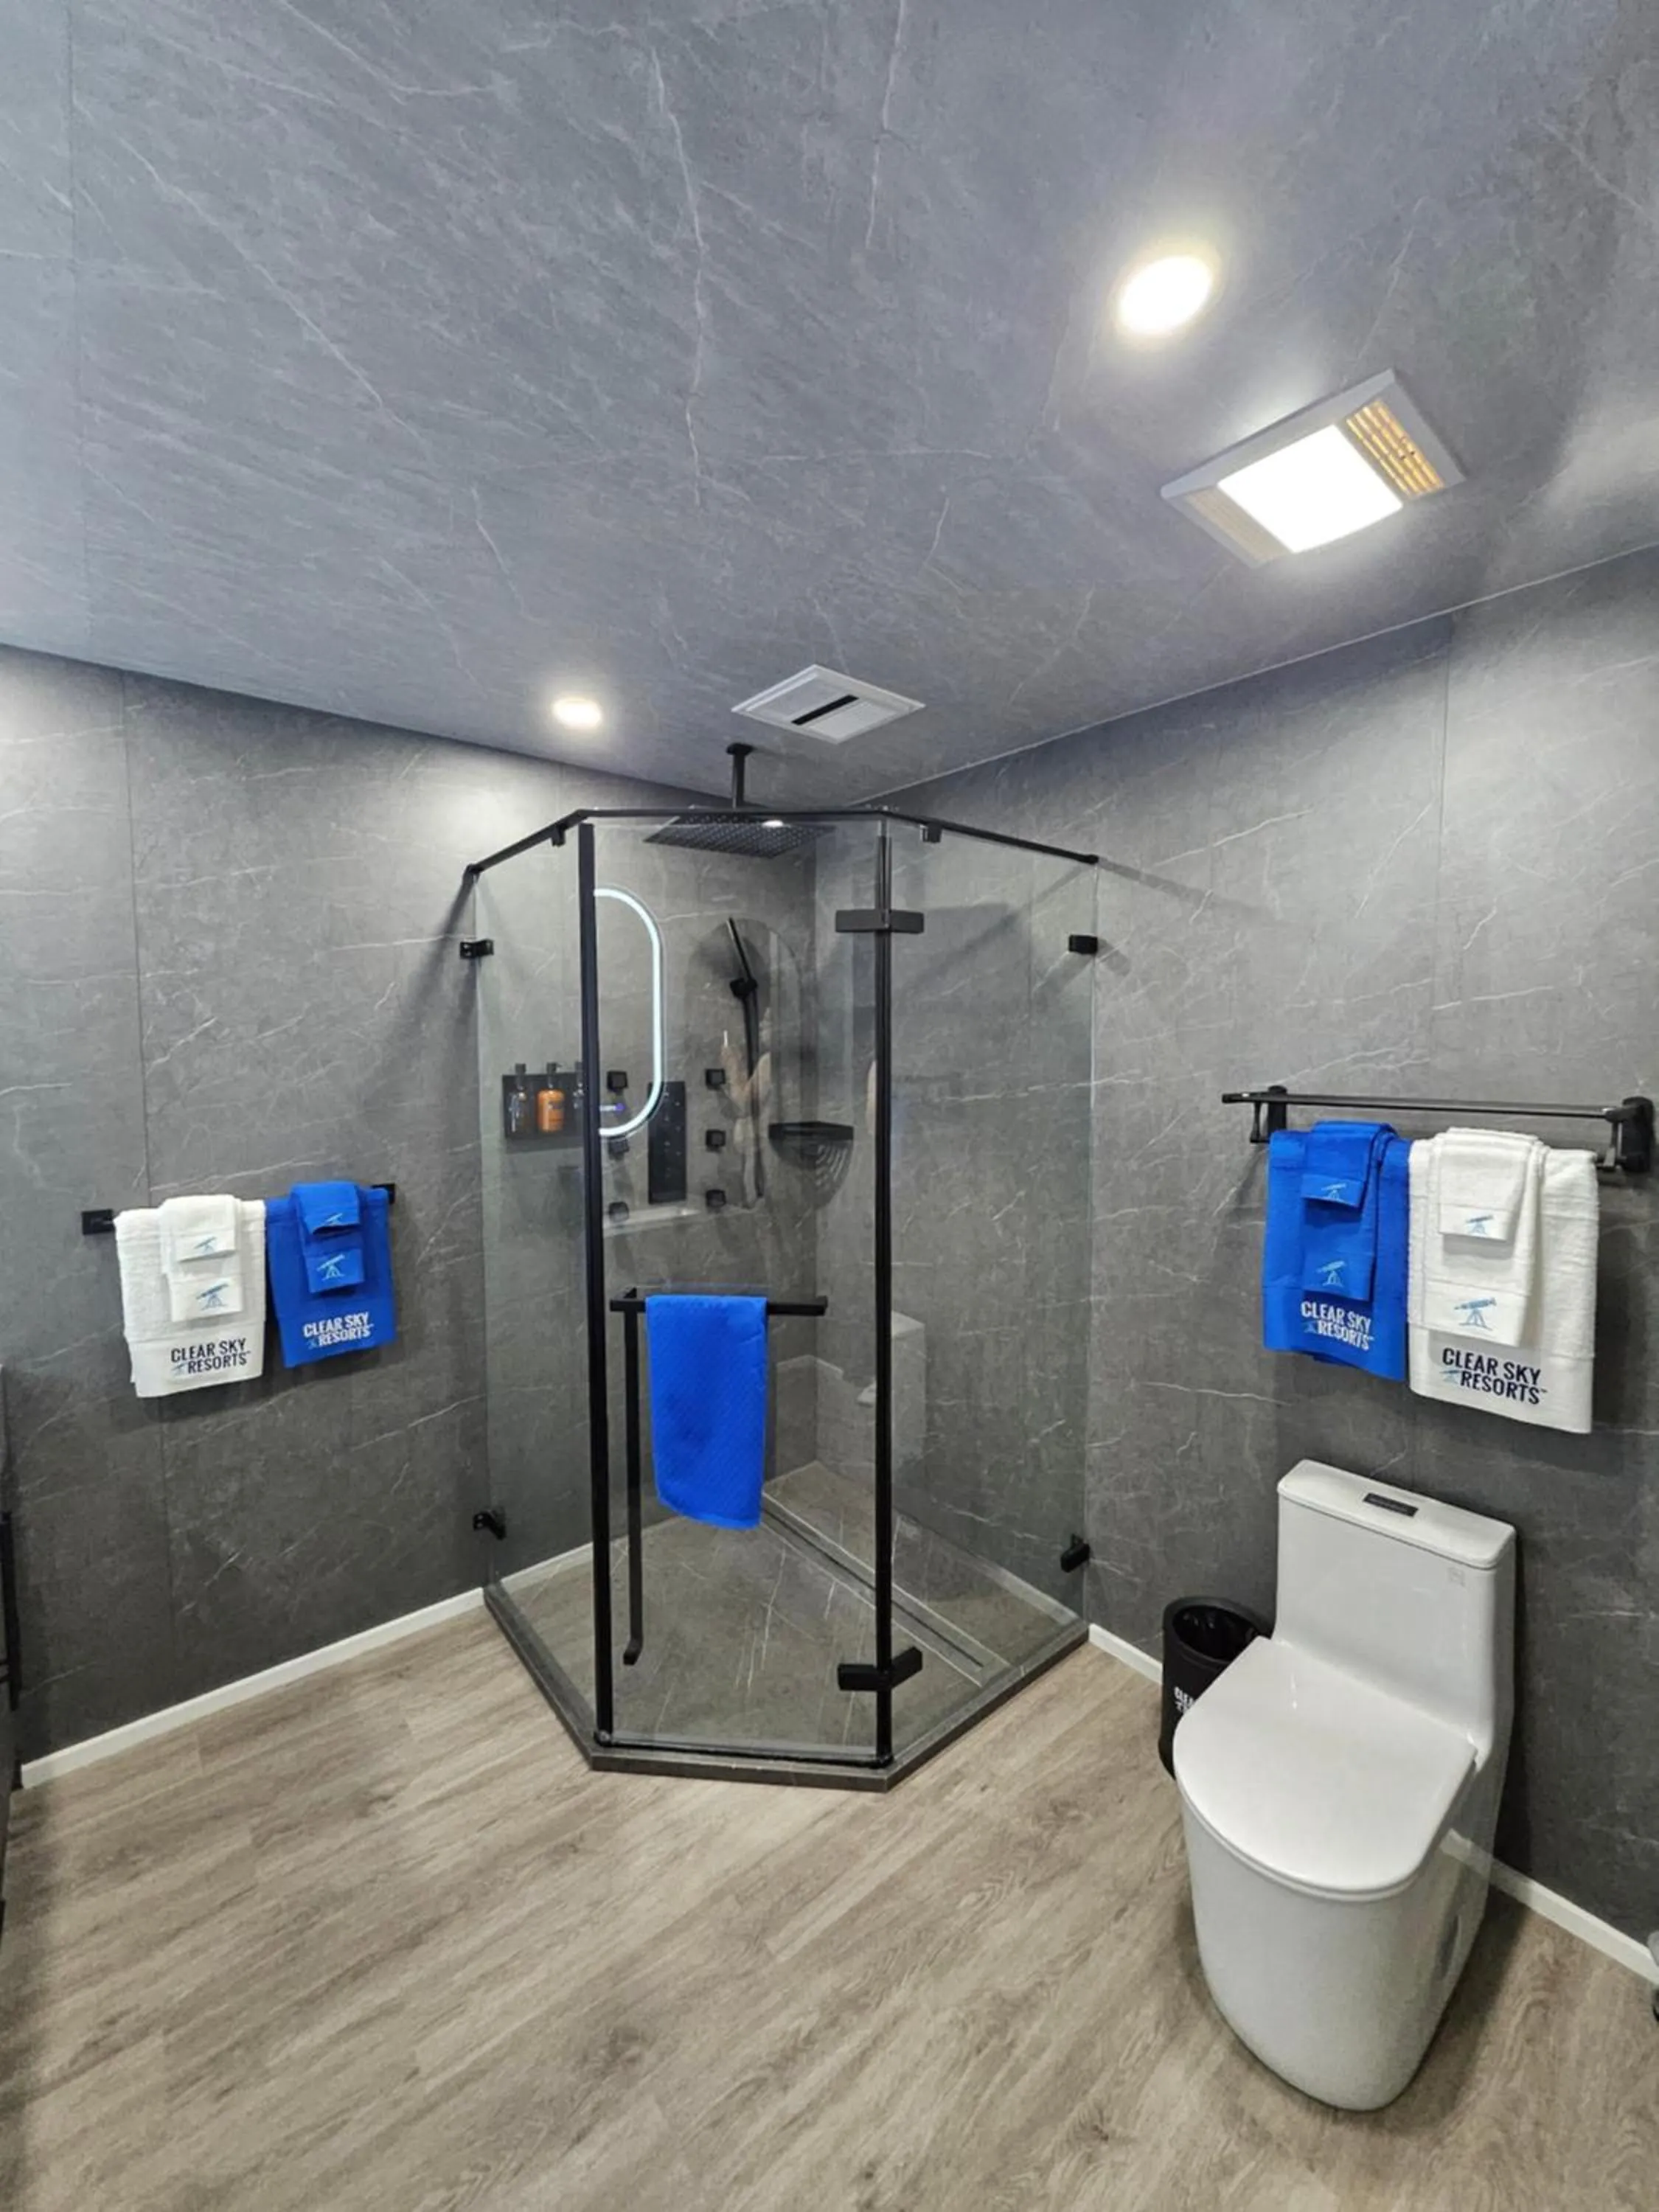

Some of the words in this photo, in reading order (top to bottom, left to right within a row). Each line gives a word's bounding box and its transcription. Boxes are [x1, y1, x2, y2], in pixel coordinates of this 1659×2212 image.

[303, 1317, 343, 1338] CLEAR
[344, 1312, 369, 1329] SKY
[1301, 1301, 1345, 1326] CLEAR
[1347, 1310, 1371, 1334] SKY
[170, 1342, 215, 1363] CLEAR
[218, 1338, 246, 1355] SKY
[318, 1326, 371, 1347] RESORTS
[1317, 1320, 1369, 1352] RESORTS
[187, 1352, 248, 1374] RESORTS
[1442, 1347, 1499, 1377] CLEAR
[1503, 1361, 1541, 1385] SKY
[1460, 1370, 1540, 1405] RESORTS
